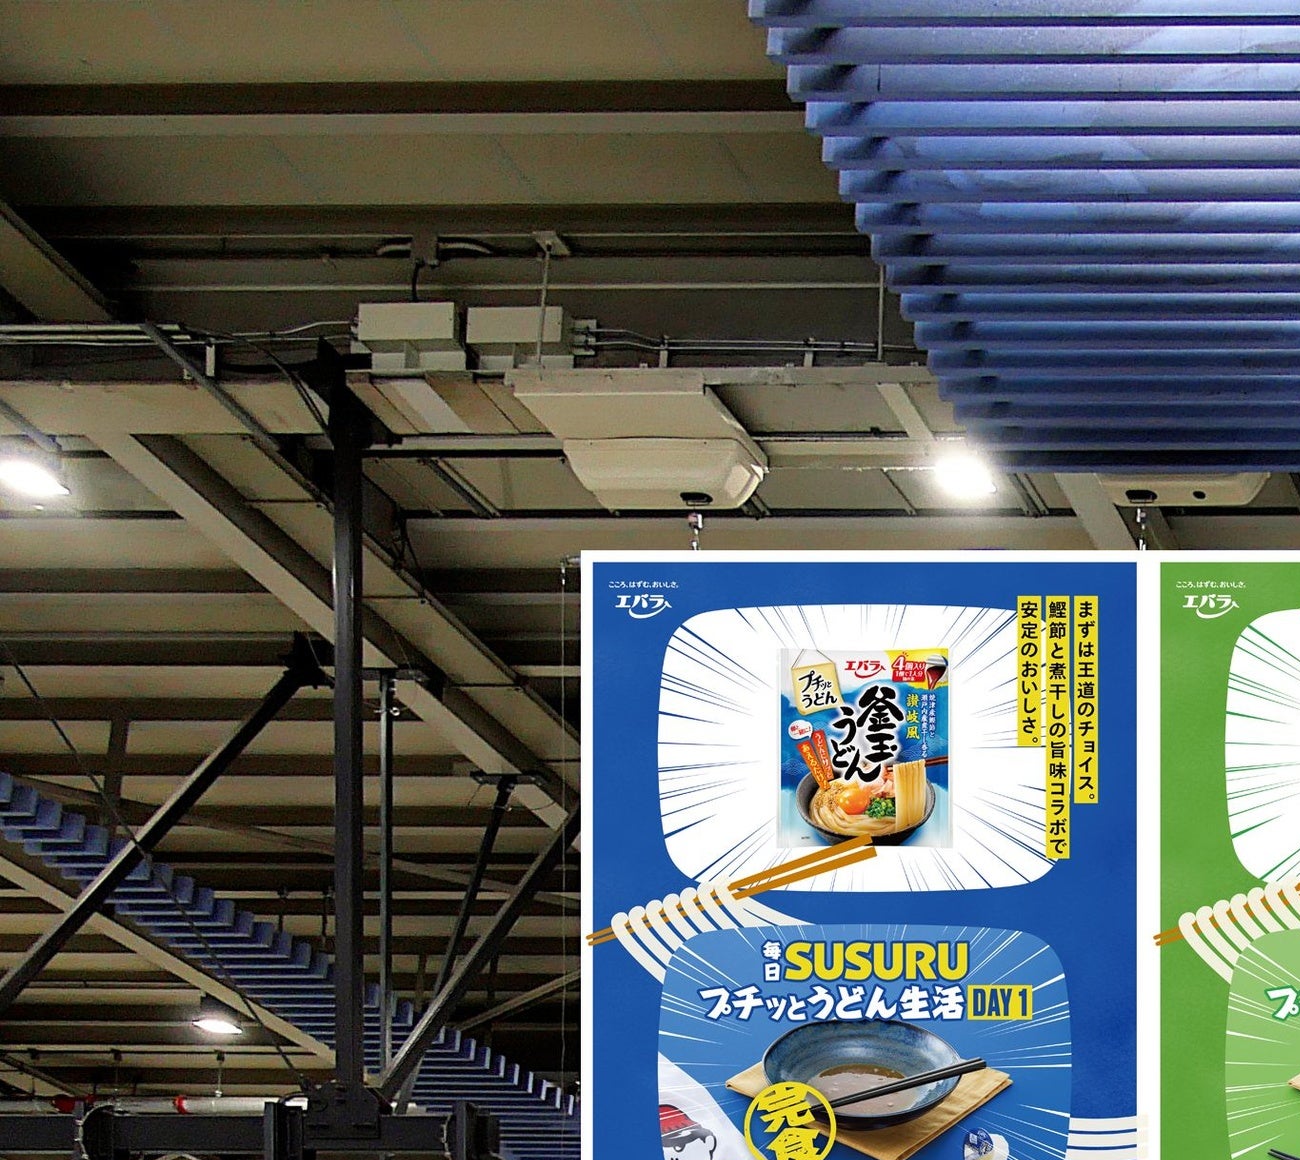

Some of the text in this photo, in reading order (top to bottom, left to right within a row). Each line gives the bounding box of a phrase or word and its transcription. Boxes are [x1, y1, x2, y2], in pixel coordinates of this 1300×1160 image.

[609, 581, 679, 589] こころ、はずむ、おいしさ。
[1176, 581, 1246, 589] こころ、はずむ、おいしさ。
[615, 594, 673, 619] エバラ
[1184, 595, 1239, 619] エバラ
[799, 670, 831, 692] プチッと
[1020, 600, 1038, 744] 安定のおいしさ。
[802, 692, 837, 708] うどん
[907, 694, 919, 739] 讃岐風
[1078, 601, 1095, 801] まずは王道のチョイス。
[857, 686, 904, 762] 釜玉
[1048, 600, 1067, 854] 鰹節と煮干しの旨味コラボで
[831, 707, 881, 782] うどん
[763, 941, 968, 981] 毎日 SUSURU
[700, 986, 1029, 1021] プチッとうどん生活 DAY 1
